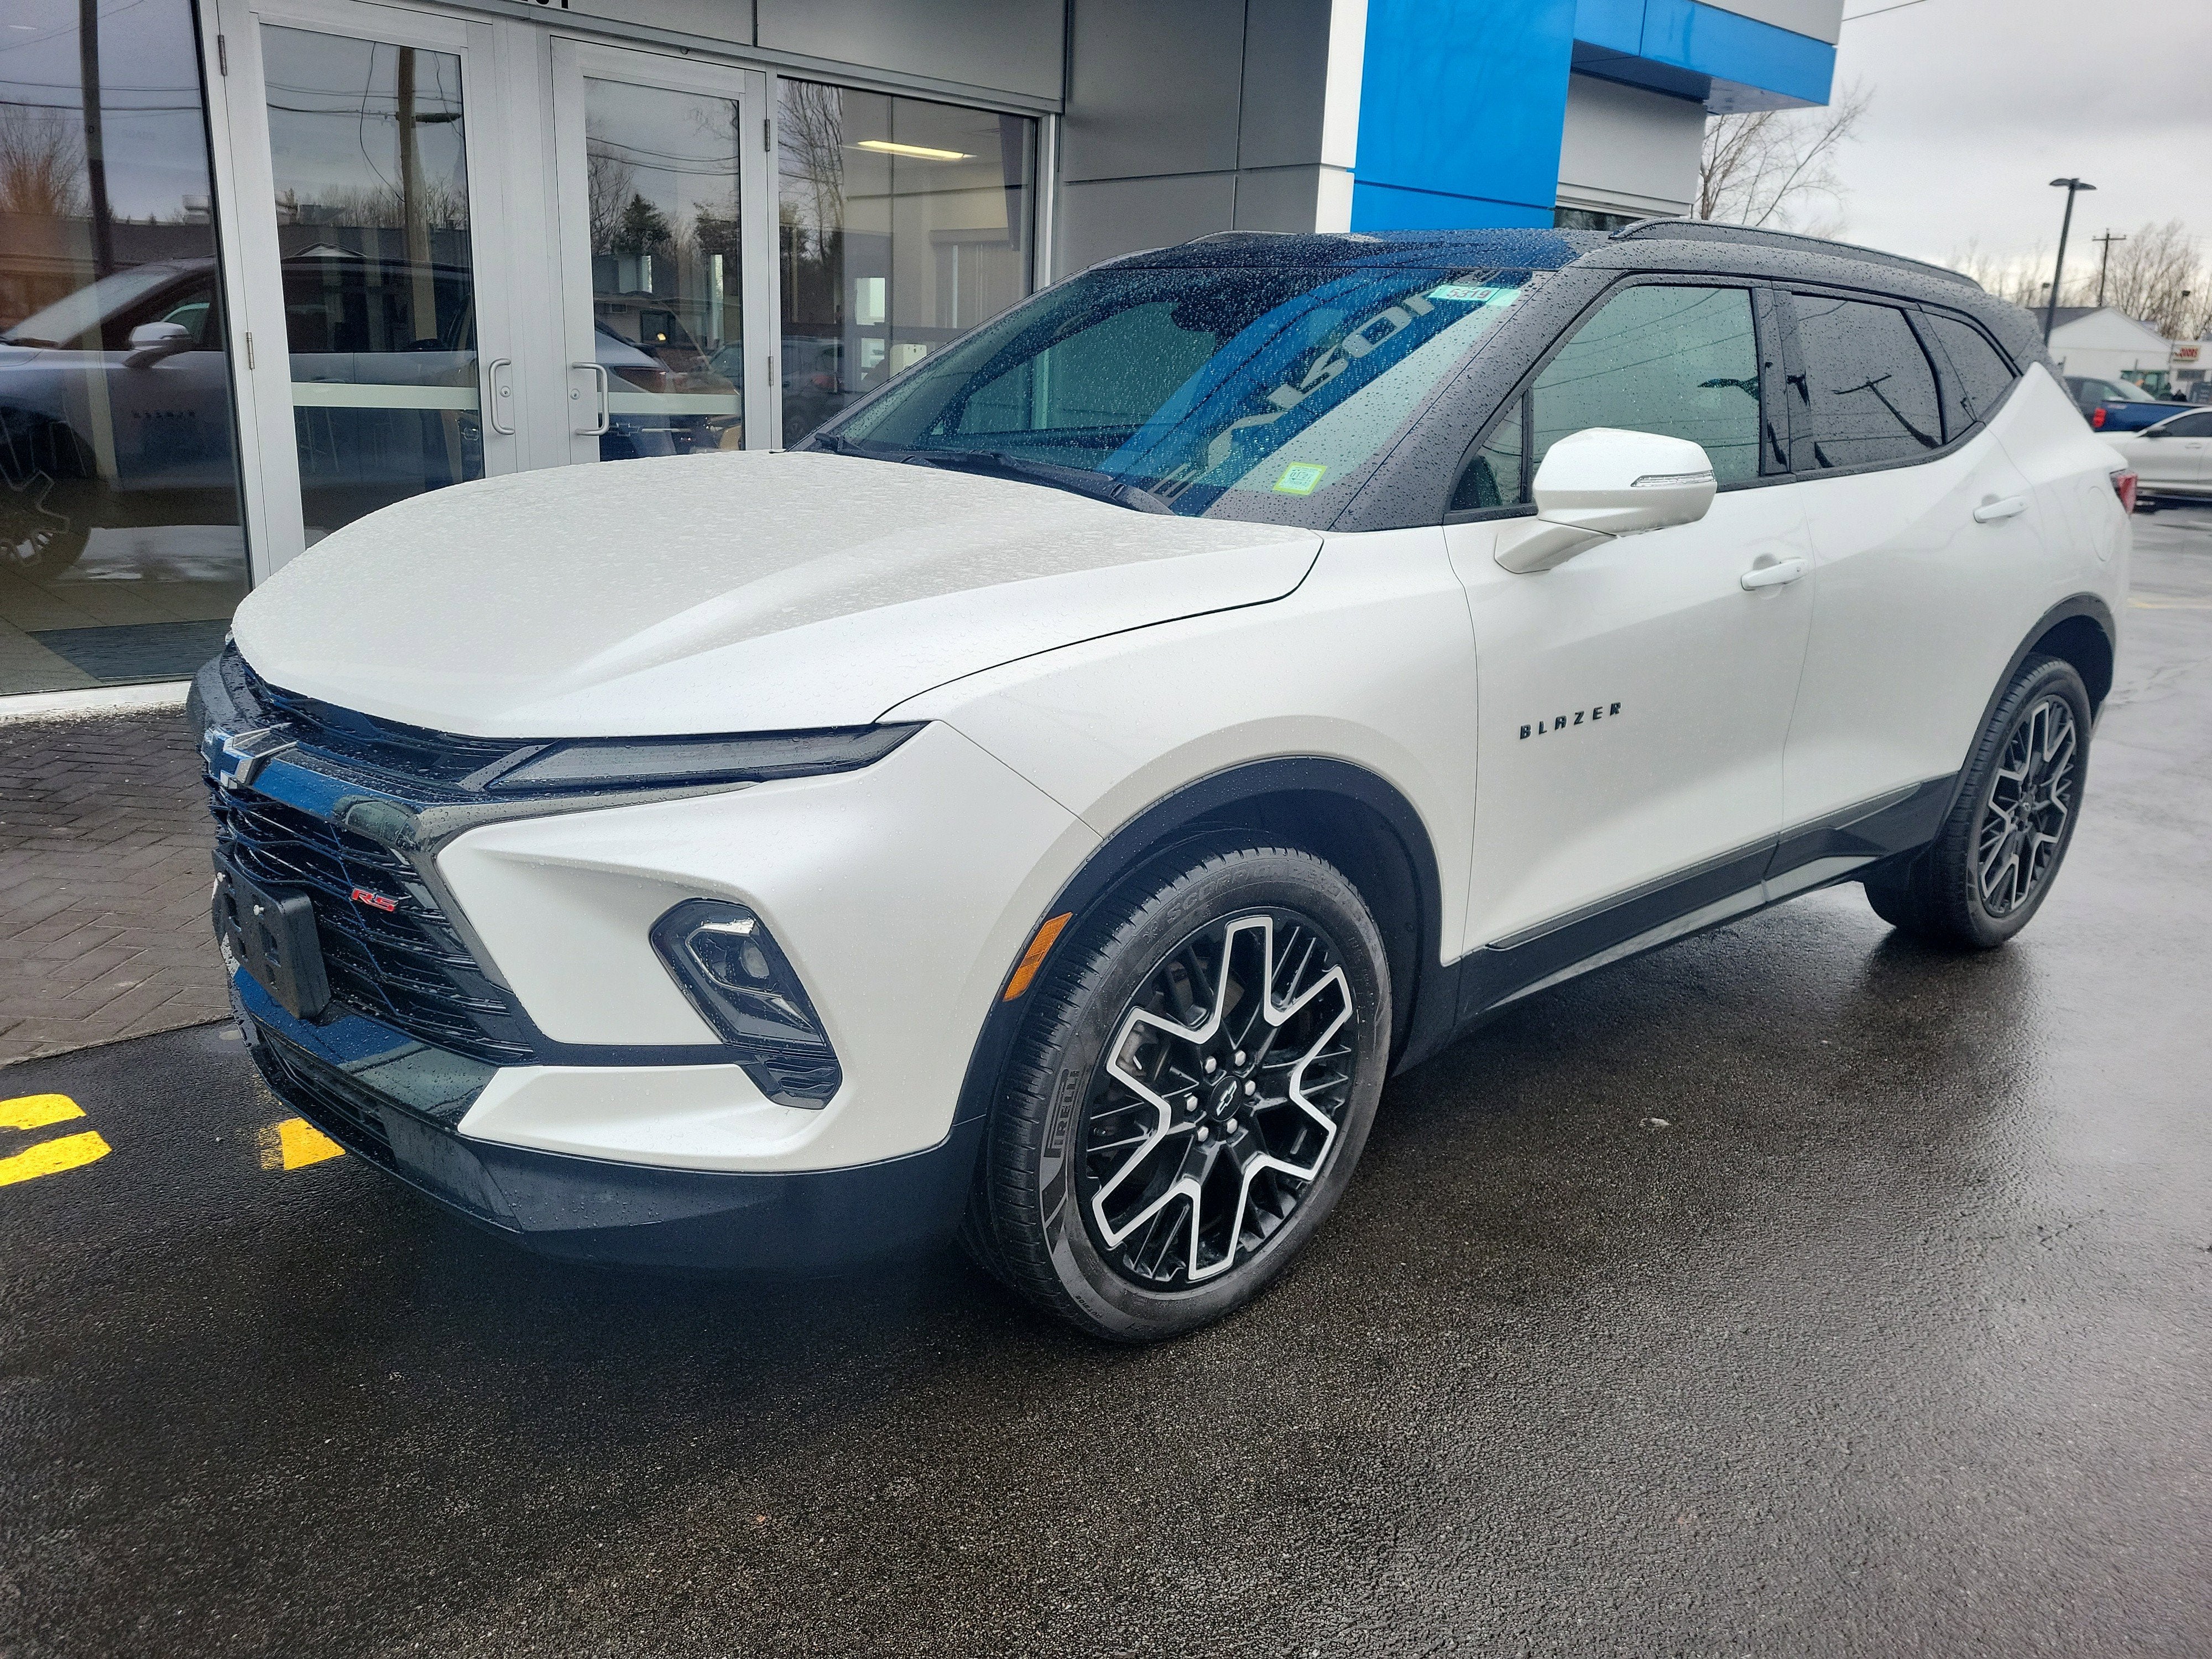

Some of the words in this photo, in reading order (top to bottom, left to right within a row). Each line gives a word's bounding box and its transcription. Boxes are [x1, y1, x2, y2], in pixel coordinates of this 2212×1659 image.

[1446, 288, 1492, 299] 5319
[1519, 701, 1621, 740] BLAZER
[351, 888, 398, 912] RS
[1043, 1068, 1080, 1158] PIRELLI
